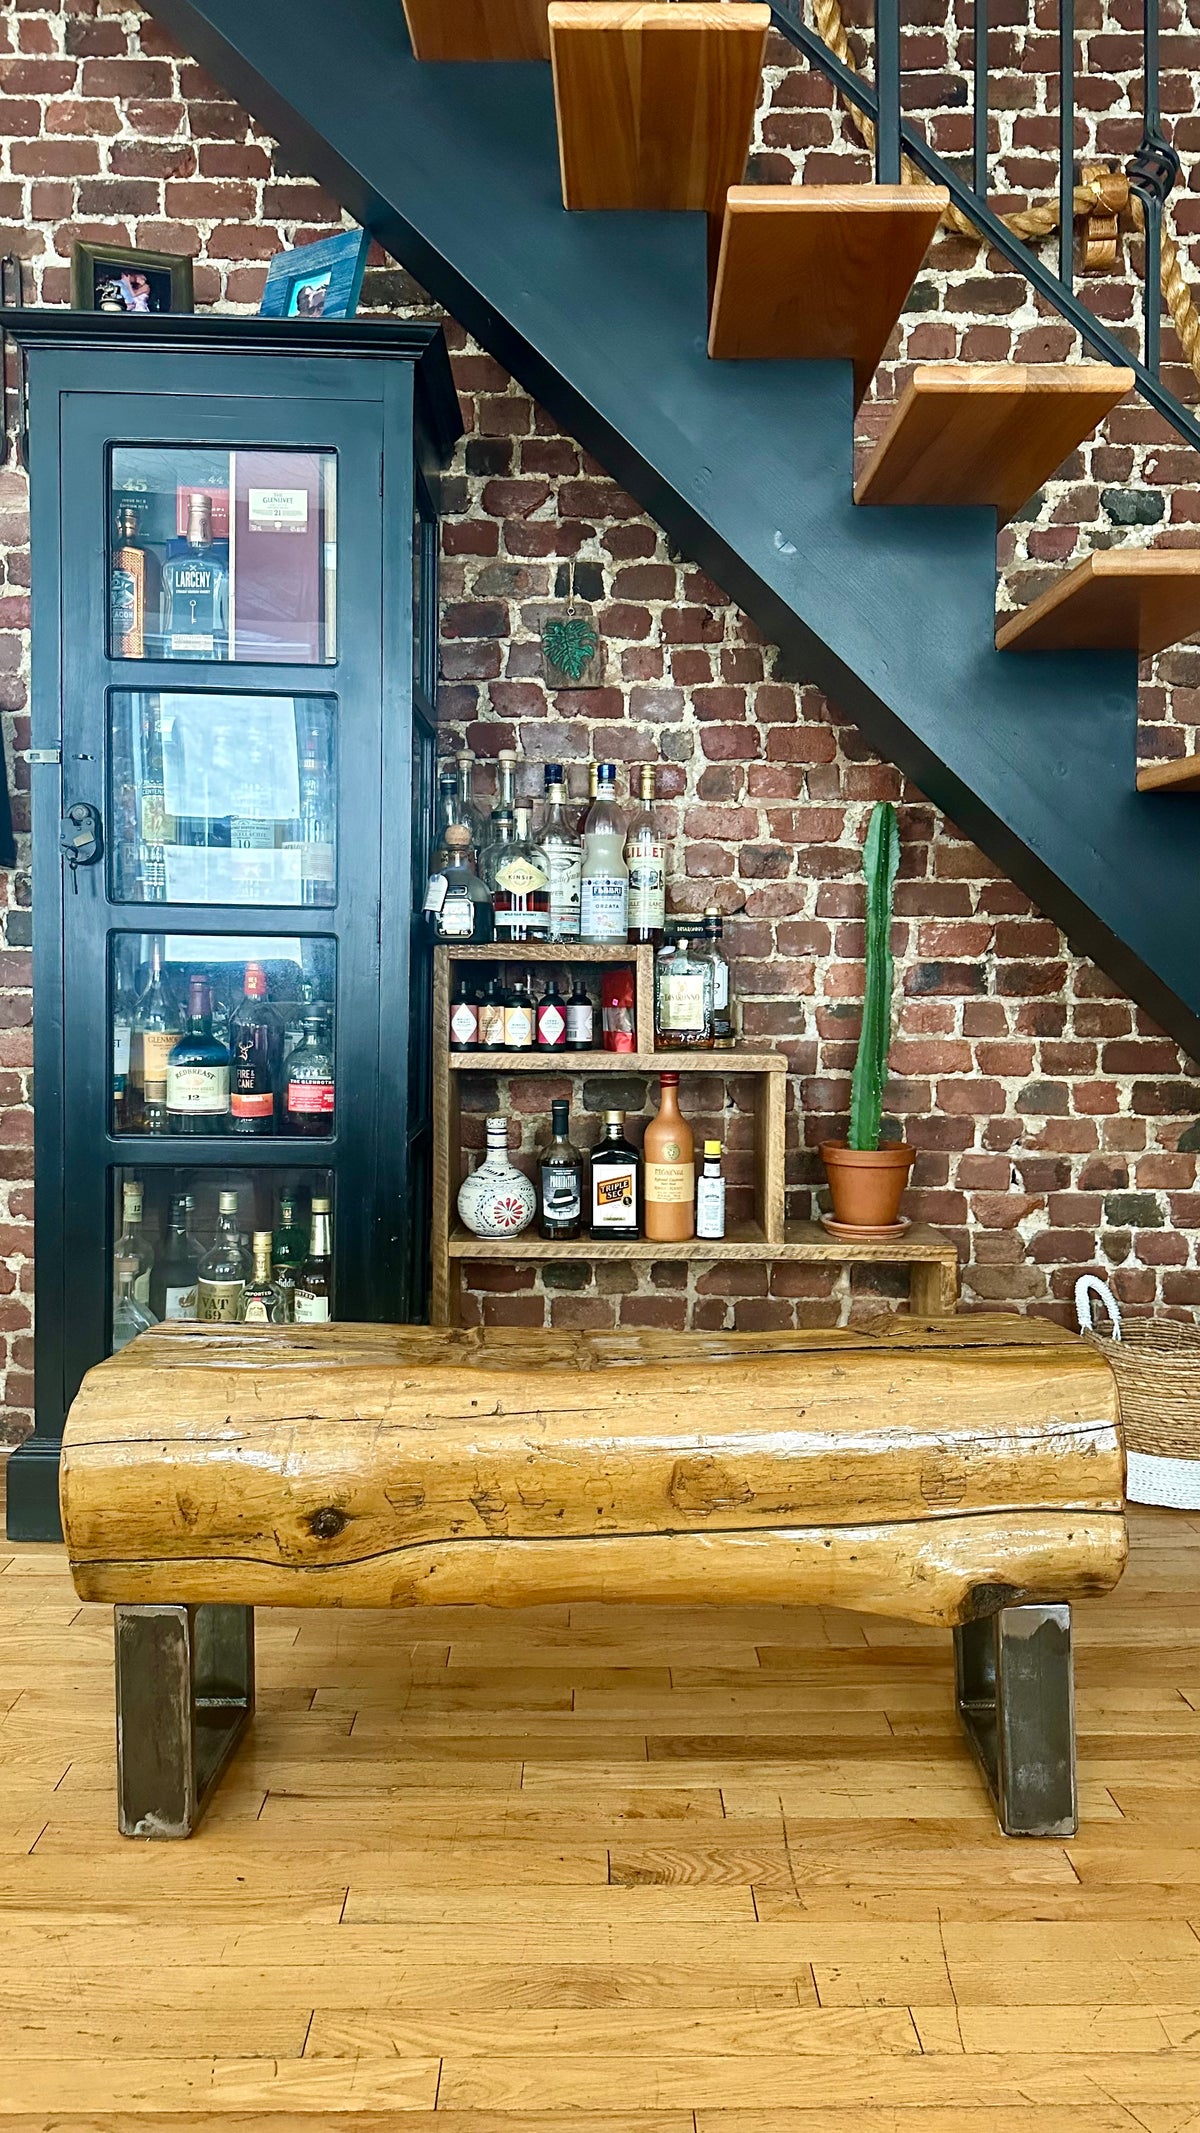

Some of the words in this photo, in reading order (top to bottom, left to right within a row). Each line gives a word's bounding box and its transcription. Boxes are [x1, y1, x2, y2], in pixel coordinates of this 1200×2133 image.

[176, 571, 211, 588] LARCENY
[239, 840, 251, 849] 10
[626, 847, 665, 859] LILLET
[175, 1069, 216, 1081] REDBREAST
[237, 1070, 249, 1079] FIRE
[238, 1079, 254, 1089] CANE
[600, 1180, 629, 1193] TRIPLE
[607, 1189, 623, 1199] SEC
[202, 1298, 229, 1310] VAT
[205, 1311, 221, 1320] 69
